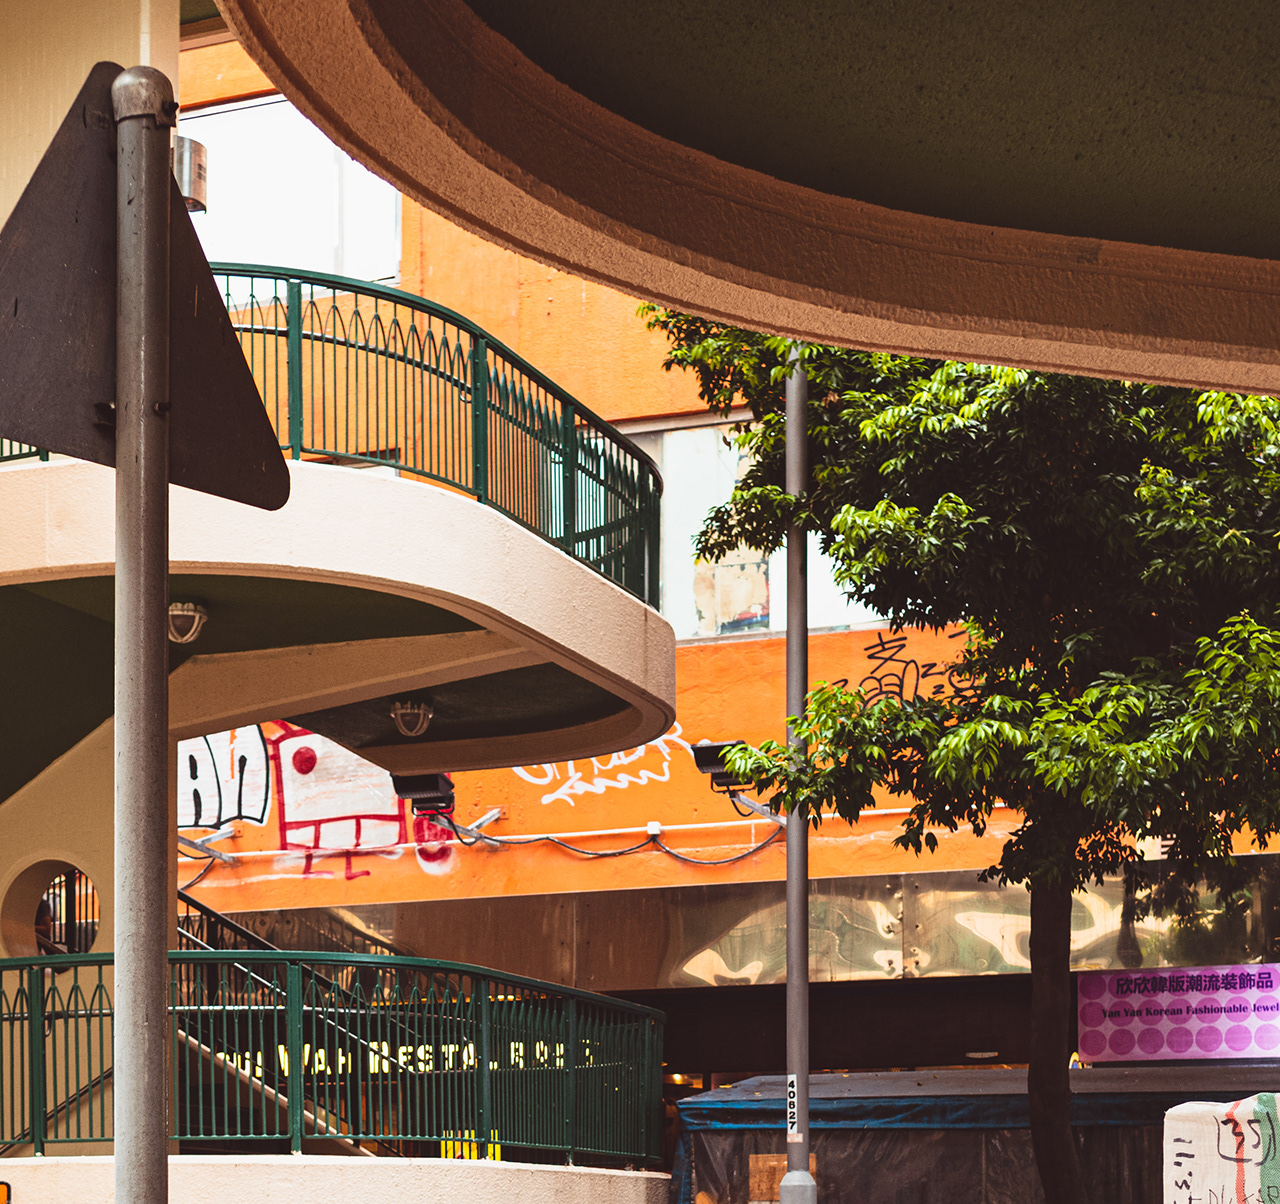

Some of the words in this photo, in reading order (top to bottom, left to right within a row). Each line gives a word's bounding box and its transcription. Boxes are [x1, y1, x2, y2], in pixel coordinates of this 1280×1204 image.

[1116, 972, 1274, 995] 欣欣韓版潮流裝飾品
[1101, 1008, 1121, 1019] Yan
[1123, 1007, 1143, 1018] Yan
[1145, 1006, 1183, 1018] Korean
[1186, 1003, 1248, 1016] Fashionable
[787, 1080, 797, 1130] 40627
